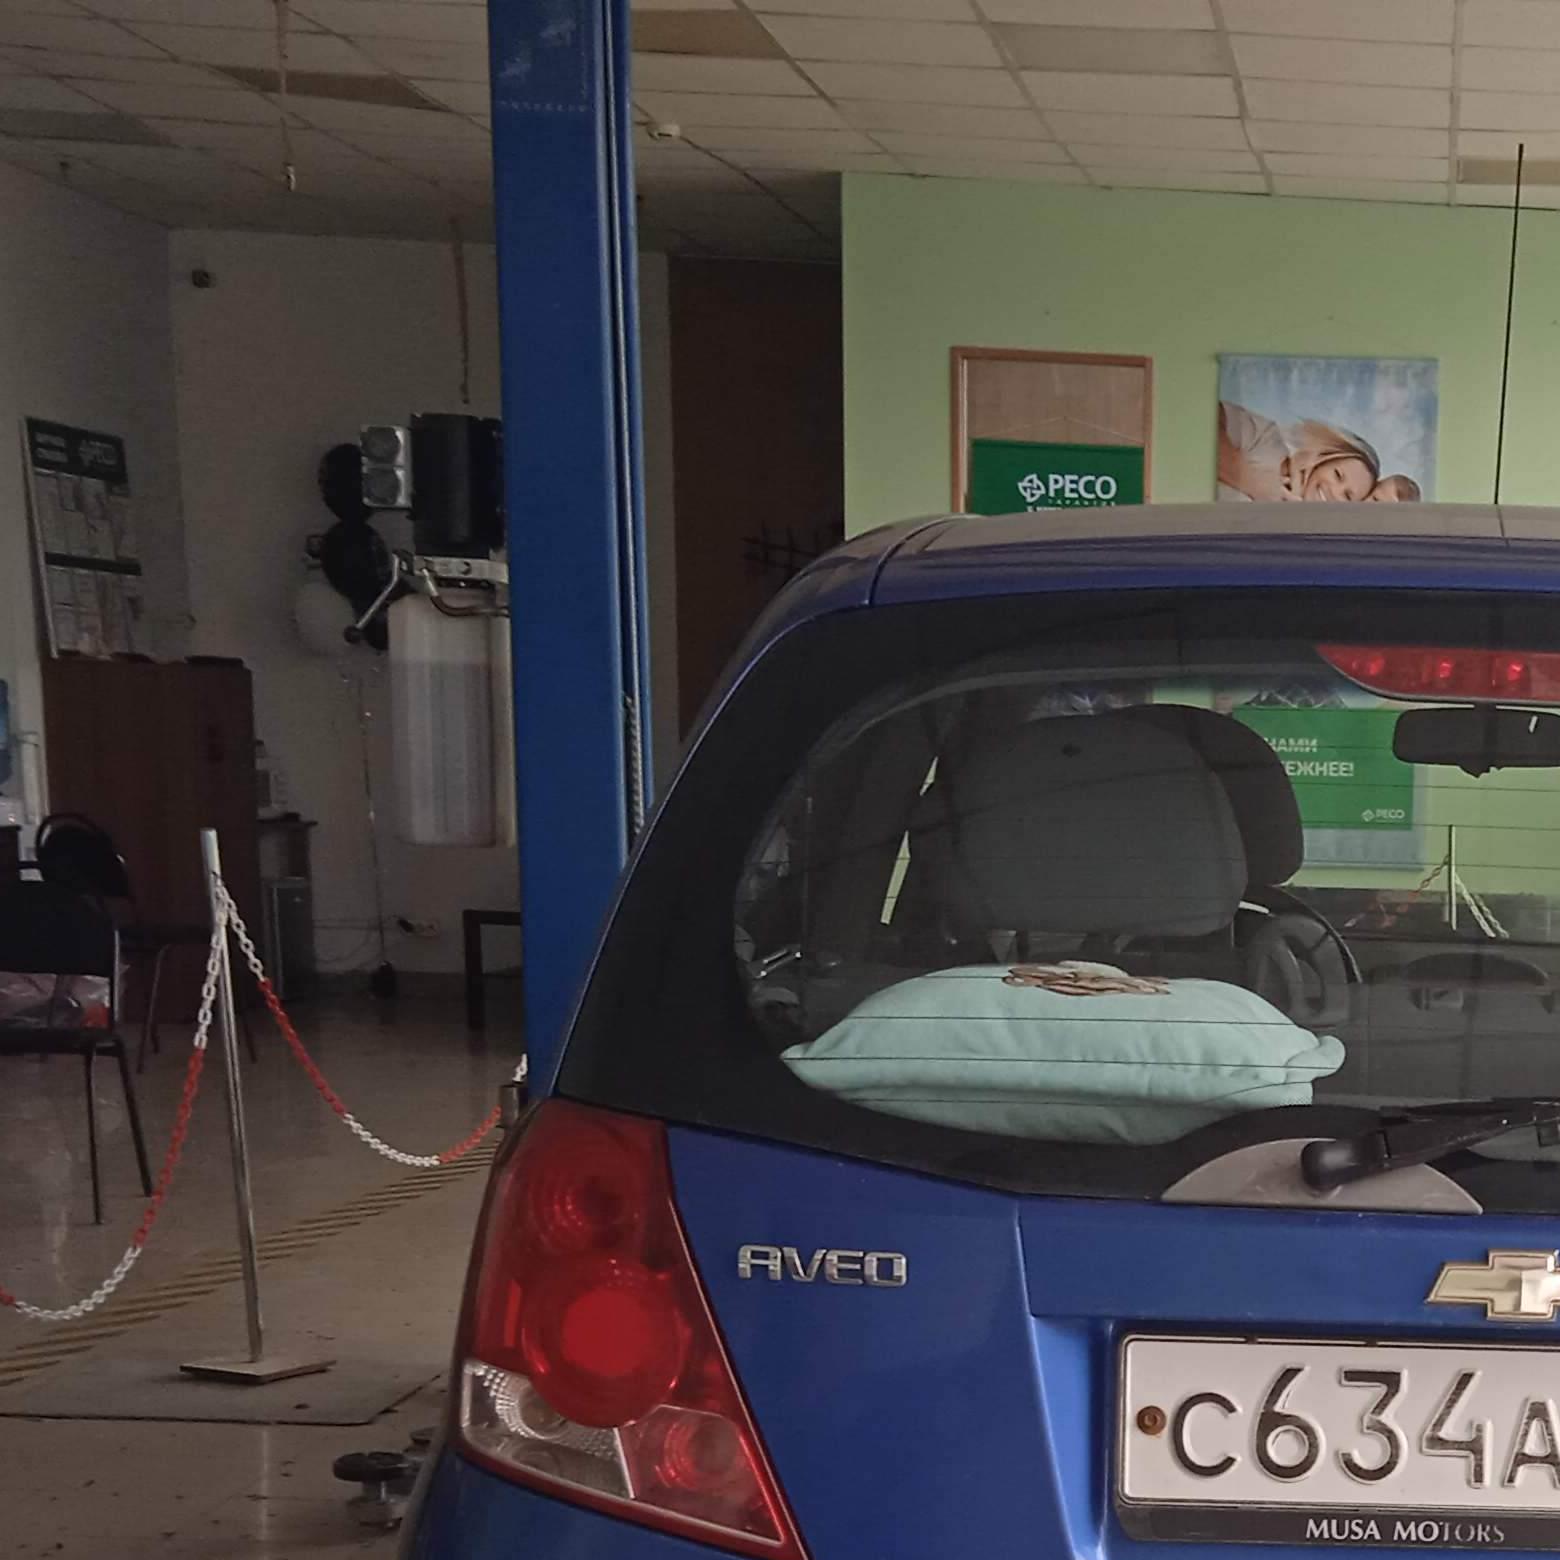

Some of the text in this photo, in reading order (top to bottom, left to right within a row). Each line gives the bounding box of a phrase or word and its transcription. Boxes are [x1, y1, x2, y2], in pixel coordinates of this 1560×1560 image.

[1281, 760, 1355, 777] ЕЖНЕЕ!
[736, 1243, 909, 1288] AVEO
[1305, 1518, 1382, 1542] MUSA
[1393, 1519, 1505, 1544] MOTORS
